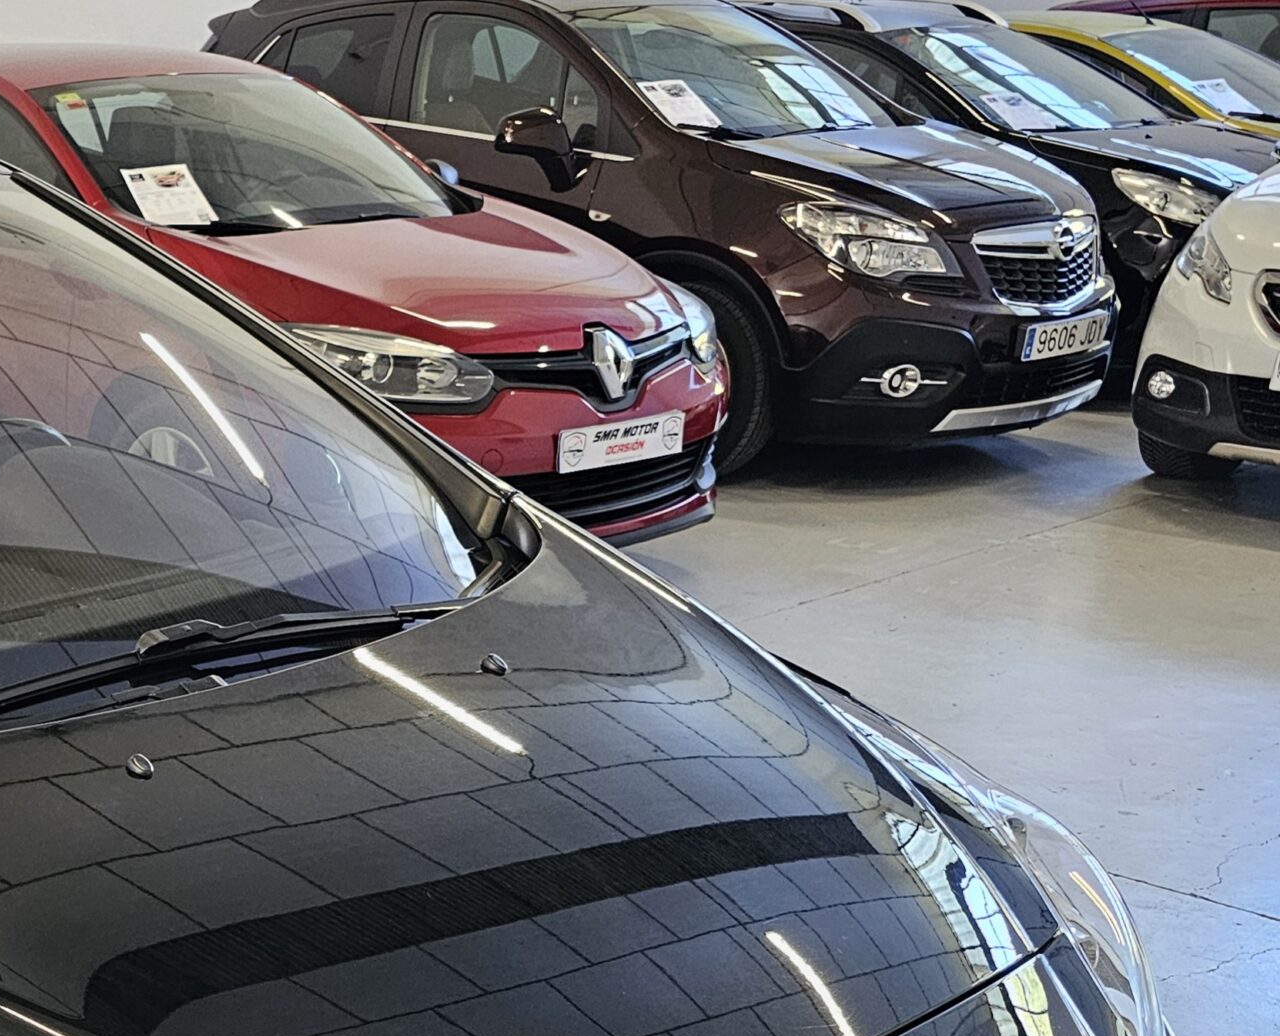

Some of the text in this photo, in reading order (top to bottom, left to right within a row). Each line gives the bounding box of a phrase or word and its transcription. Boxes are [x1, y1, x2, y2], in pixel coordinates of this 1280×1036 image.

[1037, 316, 1106, 354] 9606 JDY
[593, 422, 659, 443] SMA MOTOR
